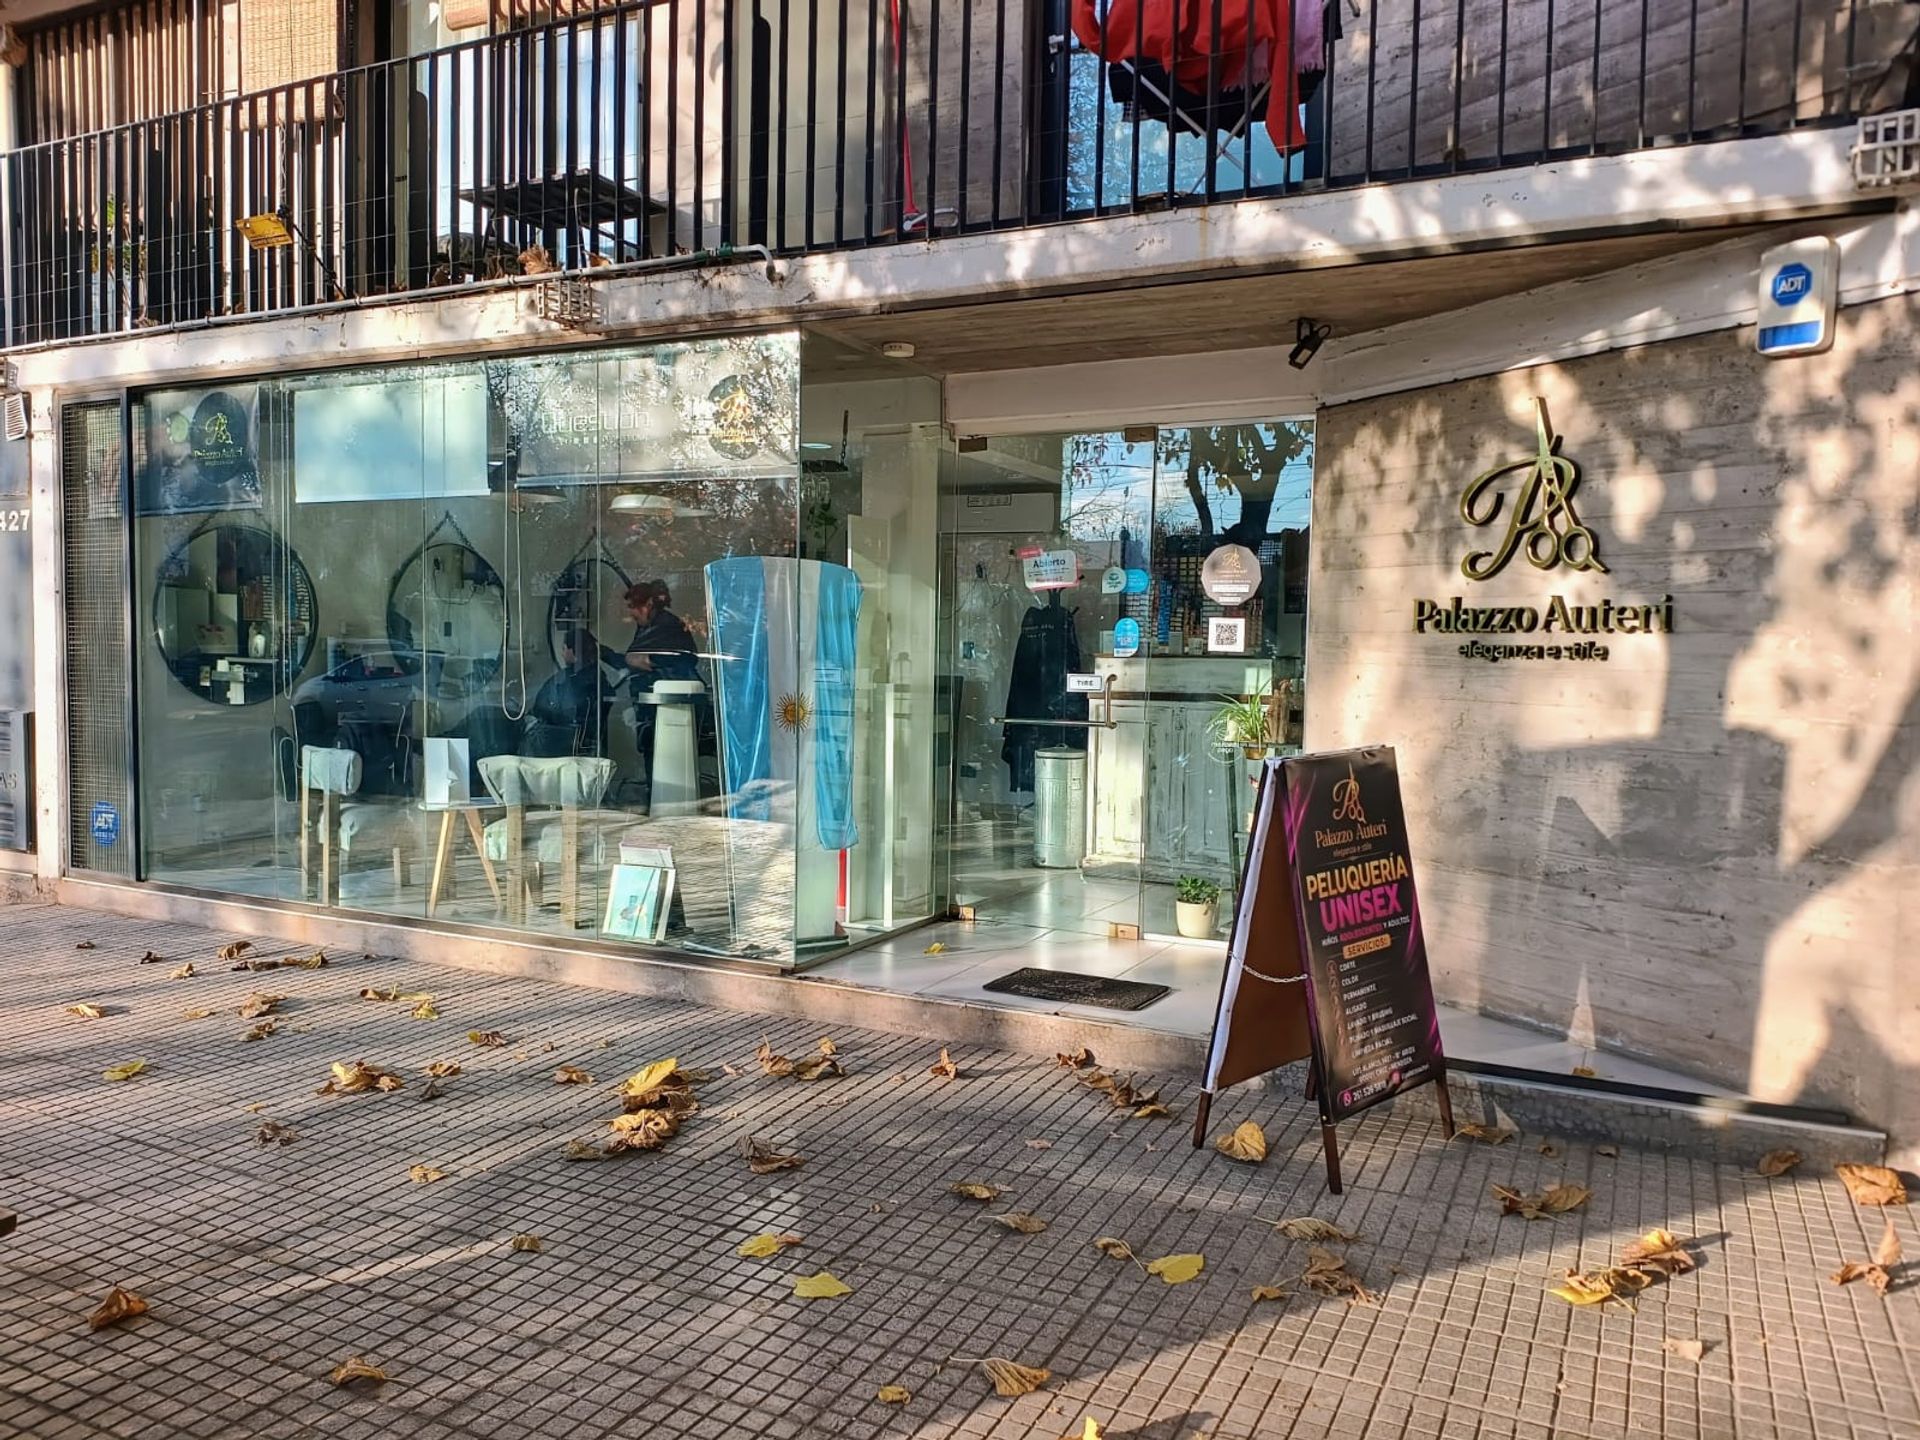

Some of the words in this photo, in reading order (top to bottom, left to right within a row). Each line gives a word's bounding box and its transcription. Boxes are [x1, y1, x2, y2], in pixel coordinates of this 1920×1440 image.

[1778, 276, 1806, 293] ADT
[1033, 558, 1066, 568] Abierto
[1411, 596, 1539, 634] Palazzo
[1540, 594, 1674, 634] Auteri
[1315, 828, 1353, 849] Palazzo
[1355, 819, 1388, 840] Auteri
[1305, 852, 1409, 901] PELUQUERÍA
[1319, 883, 1403, 932] UNISEX
[1339, 960, 1356, 972] CORTE
[1341, 975, 1359, 987] COLOR
